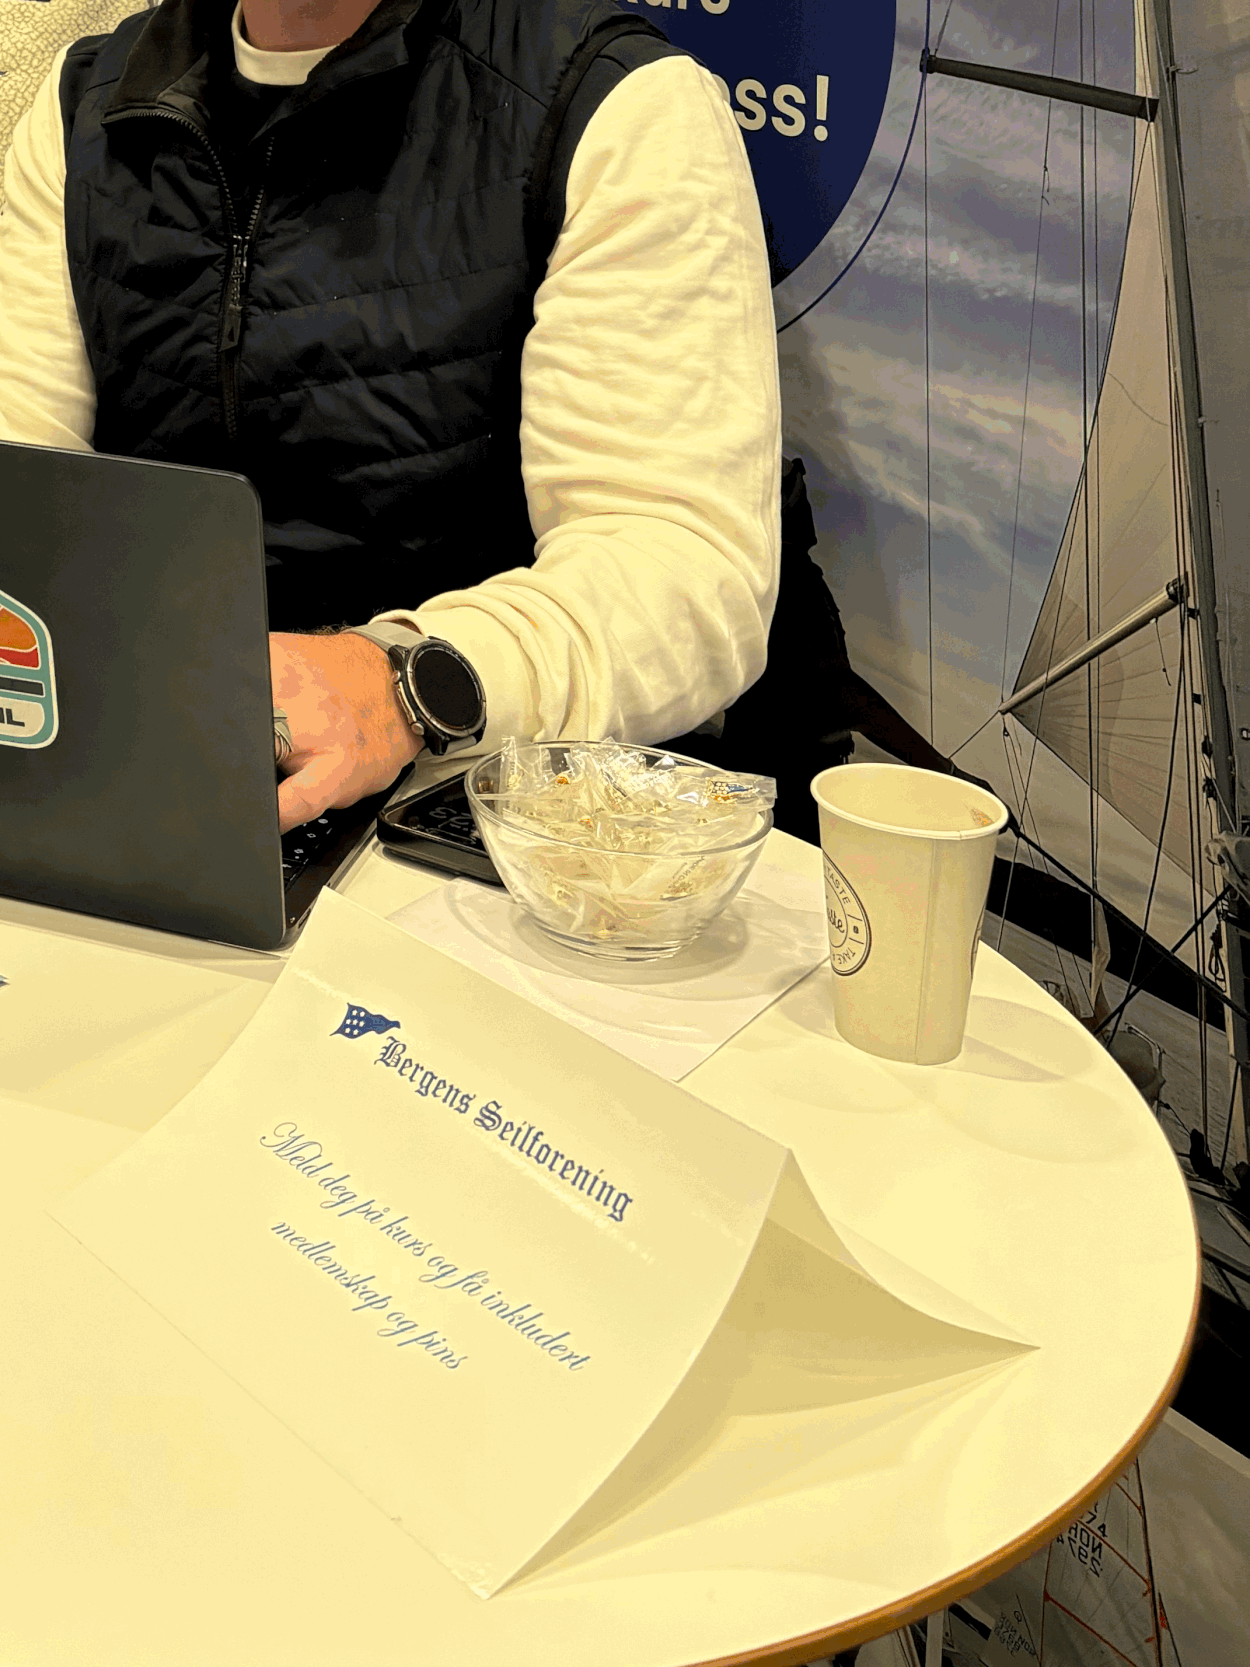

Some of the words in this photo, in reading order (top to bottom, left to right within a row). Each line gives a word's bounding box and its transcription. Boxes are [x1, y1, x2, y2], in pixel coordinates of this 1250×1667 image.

[713, 73, 830, 142] ss!
[373, 1036, 477, 1114] Bergens
[473, 1100, 634, 1222] Seilforening
[260, 1122, 333, 1178] Meld
[318, 1174, 358, 1210] deg
[337, 1199, 391, 1225] på
[379, 1216, 433, 1258] kurs
[271, 1221, 393, 1312] medlemskap
[418, 1255, 460, 1284] og
[434, 1270, 490, 1297] få
[376, 1311, 419, 1338] og
[480, 1290, 591, 1371] inkludert
[396, 1330, 469, 1370] pins
